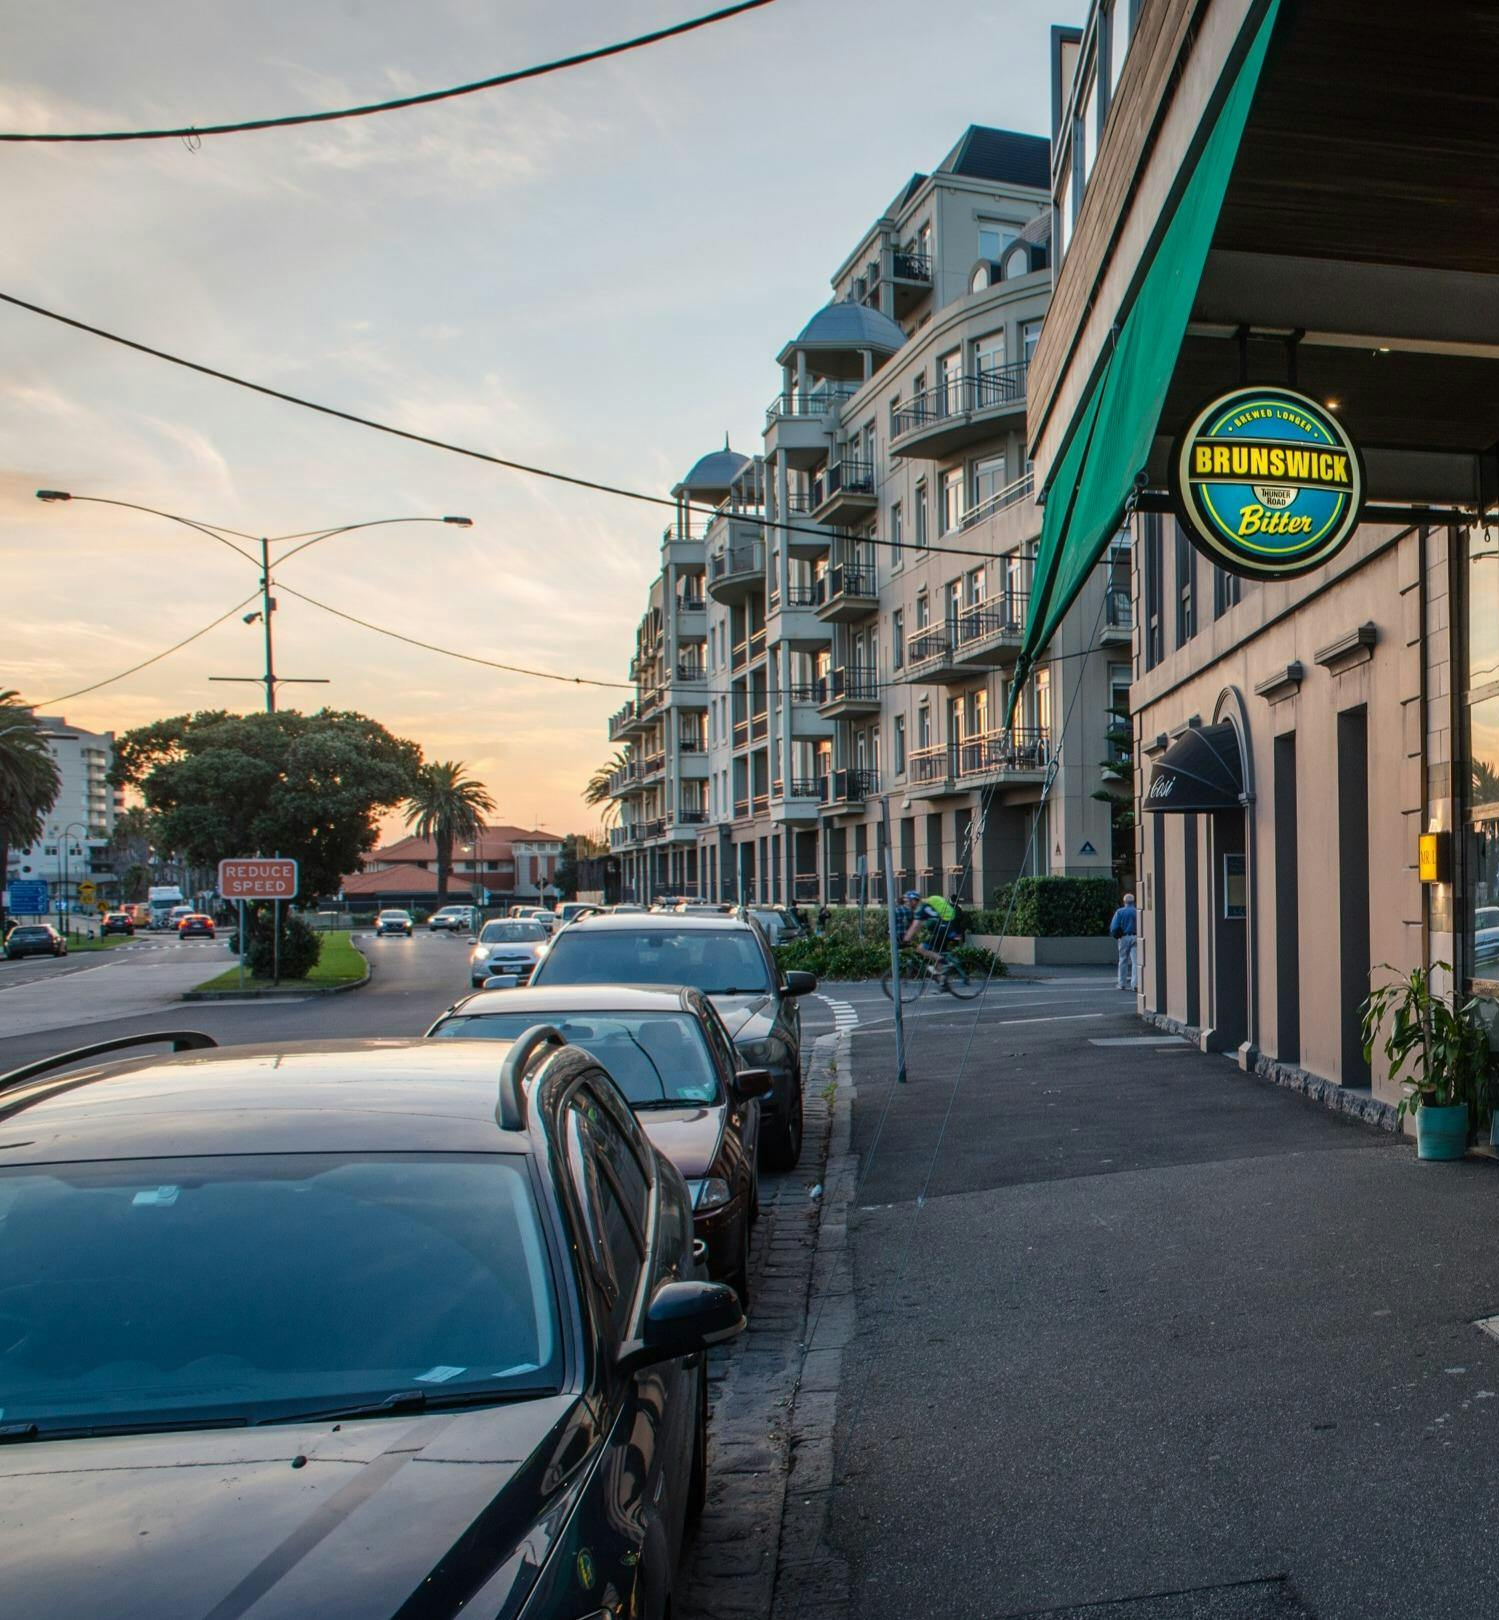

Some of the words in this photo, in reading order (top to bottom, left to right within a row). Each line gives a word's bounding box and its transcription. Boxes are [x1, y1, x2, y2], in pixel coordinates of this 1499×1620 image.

[1234, 408, 1273, 429] BREWED
[1276, 410, 1312, 433] LONGER
[1195, 445, 1350, 484] BRUNSWICK
[1261, 488, 1291, 499] THUNDER
[1266, 497, 1286, 507] ROAD
[1237, 504, 1313, 537] Bitter
[226, 866, 292, 877] REDUCE
[232, 880, 286, 892] SPEED
